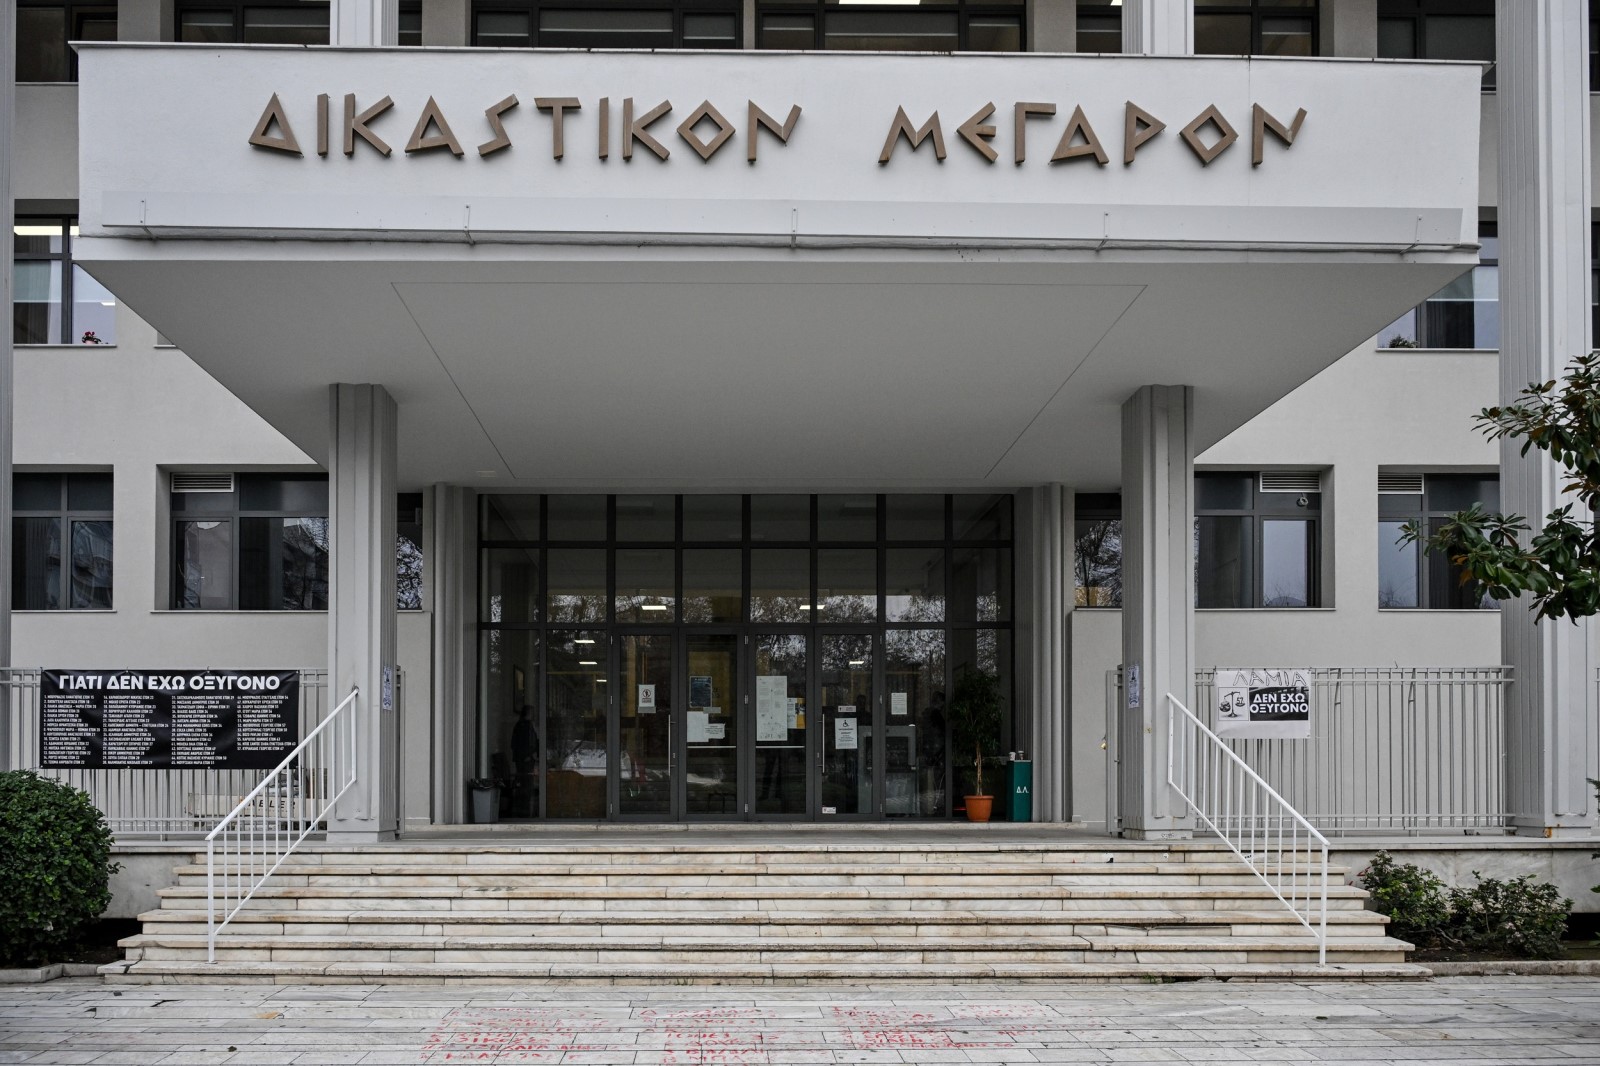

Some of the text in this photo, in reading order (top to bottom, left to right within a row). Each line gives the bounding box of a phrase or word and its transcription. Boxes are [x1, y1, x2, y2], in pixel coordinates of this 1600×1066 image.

[247, 91, 1308, 166] ΔΙΚΑΣΤΙΚΟΝ ΜΕΓΑΡΟΝ
[59, 675, 280, 690] ΓΙΑΤΙ ΔΕΝ ΕΧΩ ΟΞΥΓΟΝΟ
[1233, 671, 1307, 686] ΛΑΜΙΑ
[1253, 693, 1305, 703] ΔΕΝ ΕΧΩ
[1250, 703, 1308, 713] ΟΞΥΓΟΝΟ
